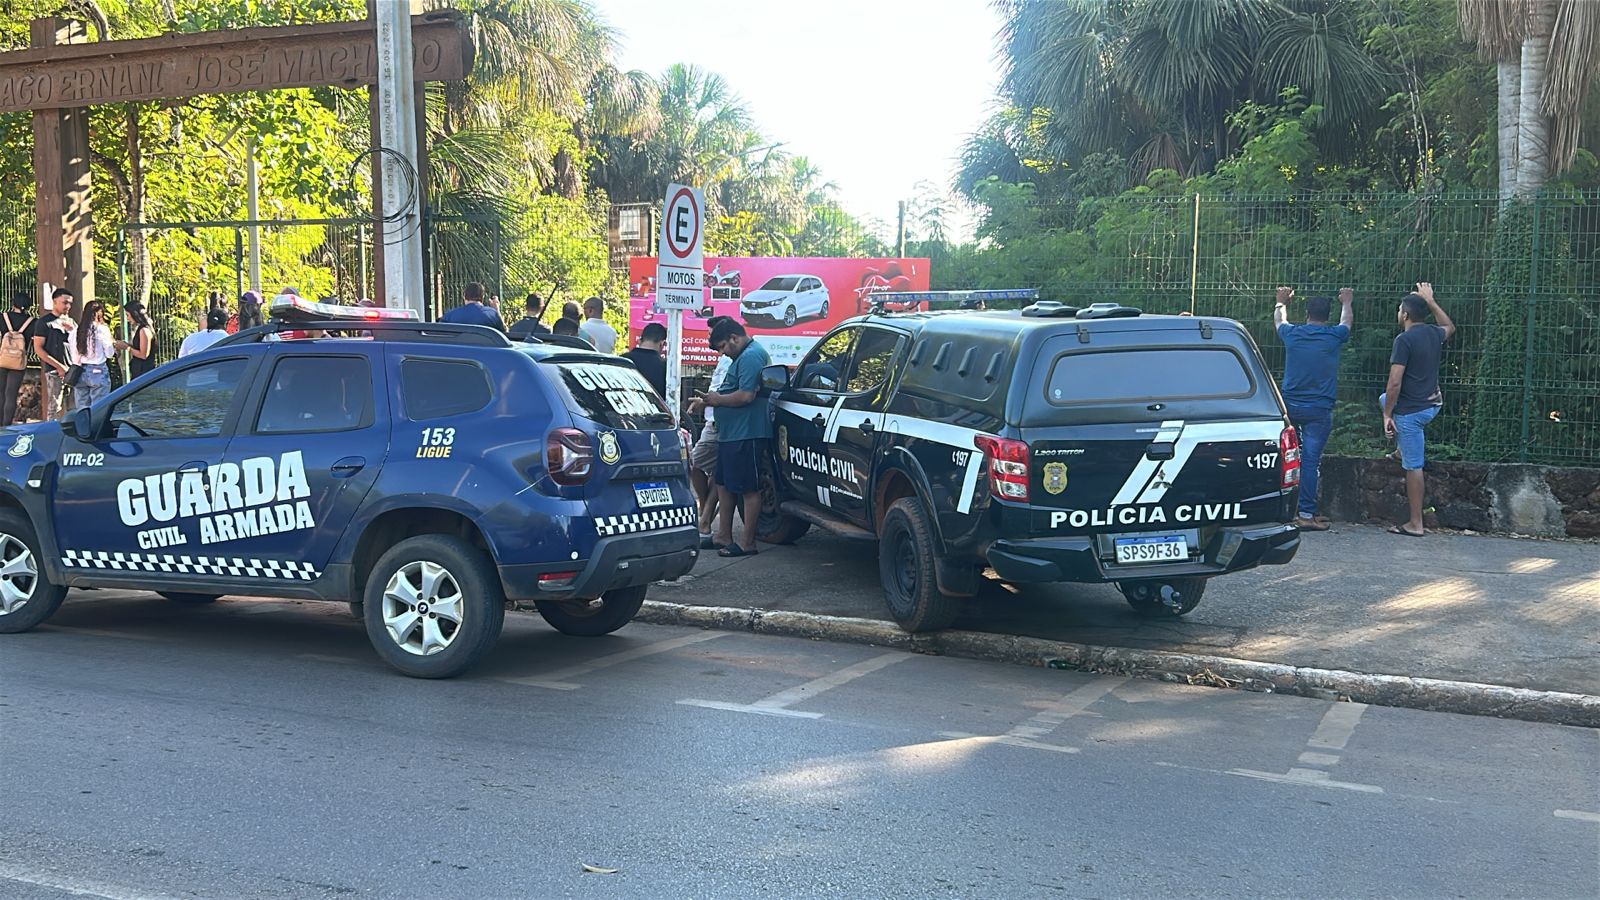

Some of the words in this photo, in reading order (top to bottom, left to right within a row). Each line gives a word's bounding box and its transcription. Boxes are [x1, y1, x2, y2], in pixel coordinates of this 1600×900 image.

[61, 62, 165, 101] ERNANI
[272, 39, 442, 85] MACHO
[675, 206, 689, 243] E
[667, 272, 696, 285] MOTOS
[665, 293, 690, 304] TÉRMINO
[421, 427, 456, 446] 153
[63, 453, 104, 467] VTR-02
[416, 446, 452, 458] LIGUE
[956, 450, 969, 467] 197
[1253, 453, 1278, 469] 197
[789, 446, 828, 475] POLÍCIA
[830, 457, 858, 484] CIVIL
[116, 450, 311, 527] GUARDA
[1050, 505, 1167, 529] POLÍCIA
[1174, 503, 1248, 522] CIVIL
[137, 525, 187, 550] CIVIL
[200, 501, 315, 545] ARMADA
[1122, 543, 1181, 560] SPS9F36
